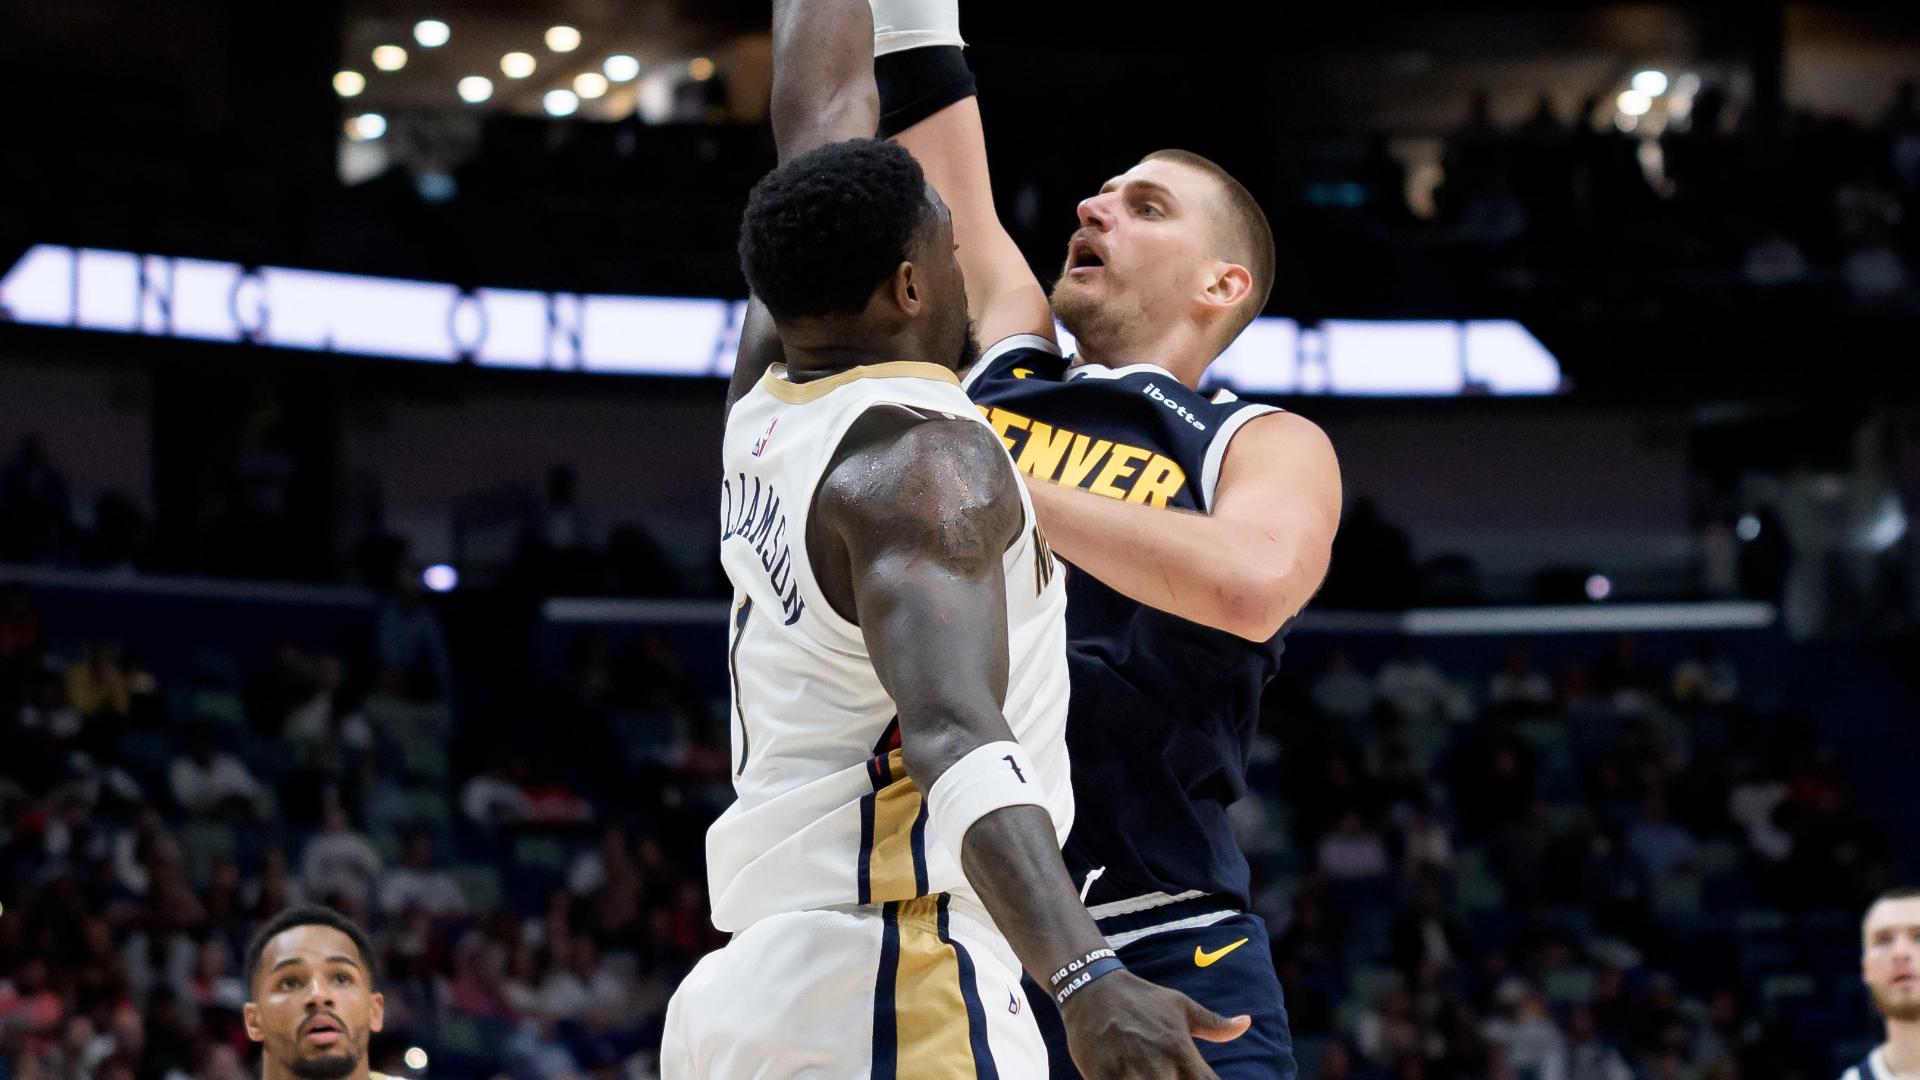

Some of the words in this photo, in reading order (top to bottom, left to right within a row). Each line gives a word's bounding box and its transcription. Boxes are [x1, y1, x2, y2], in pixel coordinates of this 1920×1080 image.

[1143, 383, 1206, 431] ibotta
[976, 404, 1186, 510] ENVER
[1002, 754, 1027, 784] 1
[1050, 967, 1069, 986] DIE
[1068, 959, 1085, 972] TO
